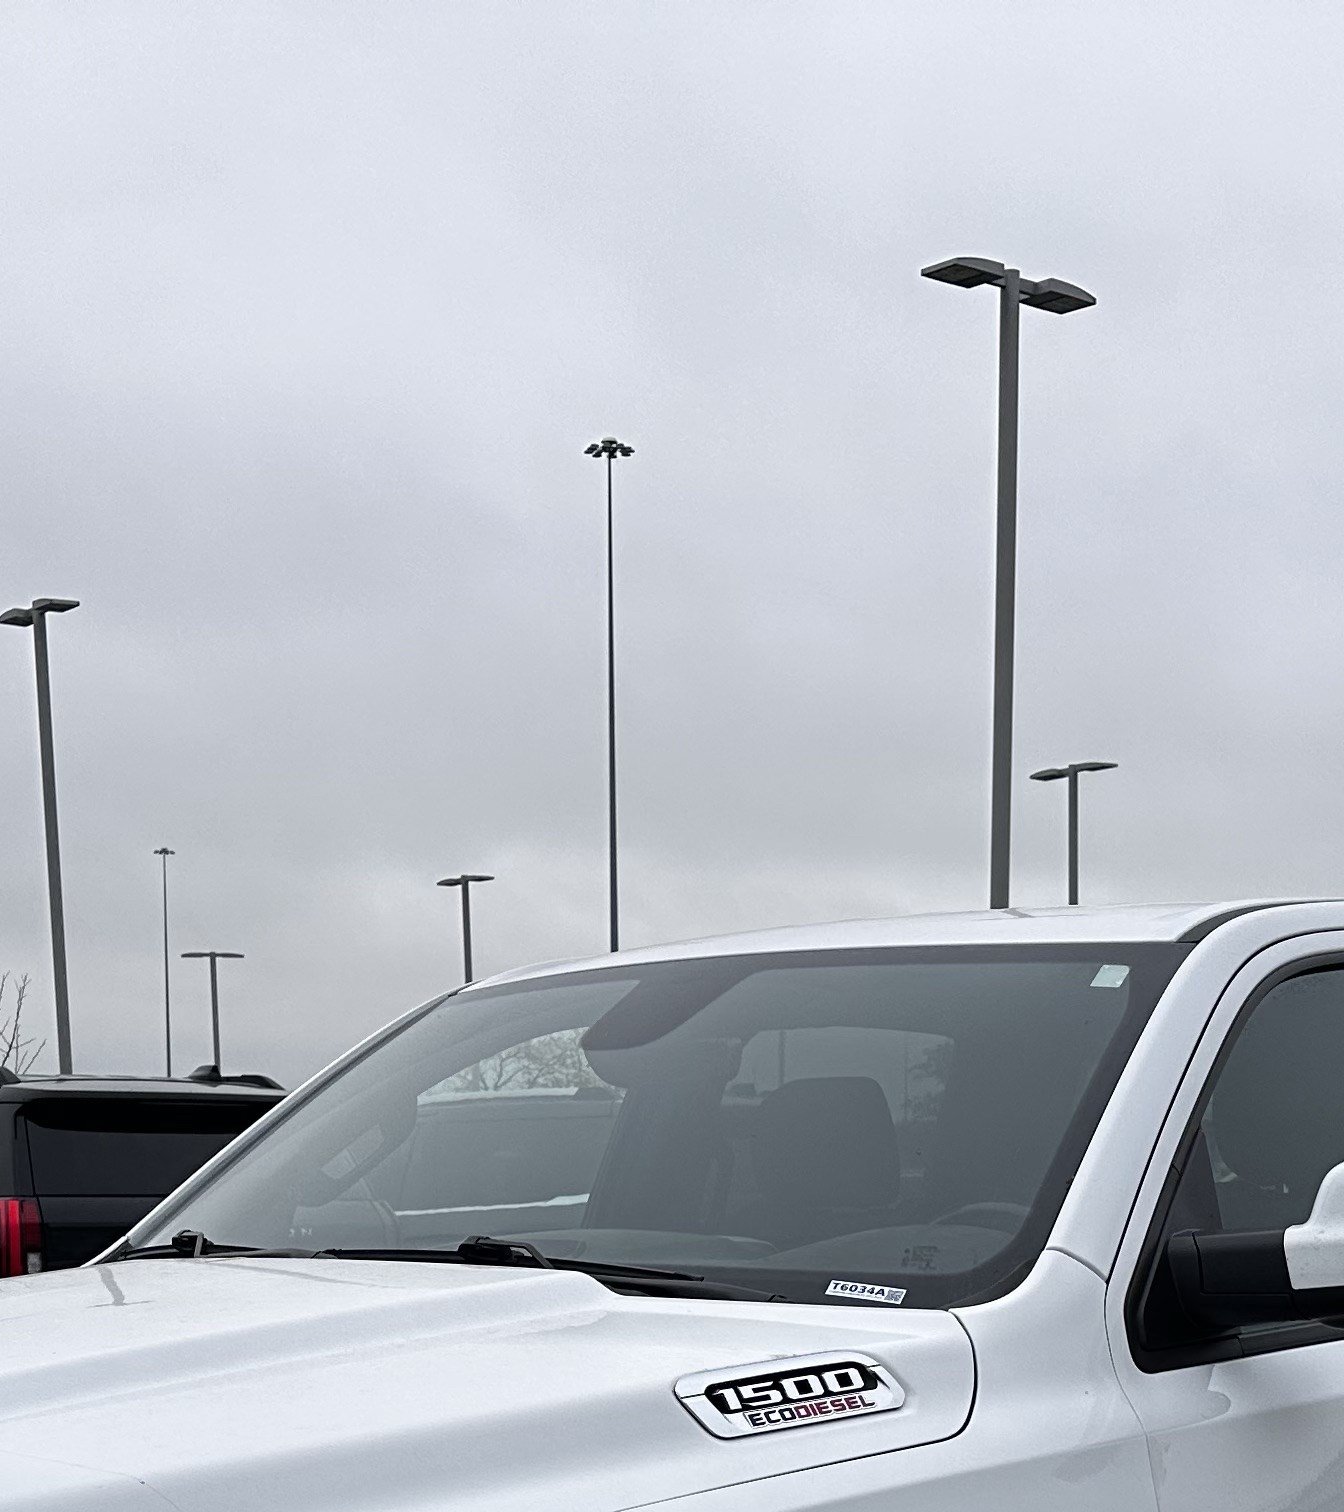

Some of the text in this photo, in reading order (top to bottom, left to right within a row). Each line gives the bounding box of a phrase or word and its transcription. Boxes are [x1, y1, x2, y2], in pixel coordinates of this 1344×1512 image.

[832, 1282, 885, 1297] T6034A
[712, 1367, 865, 1411] 1500
[747, 1394, 876, 1427] ECODIESEL
